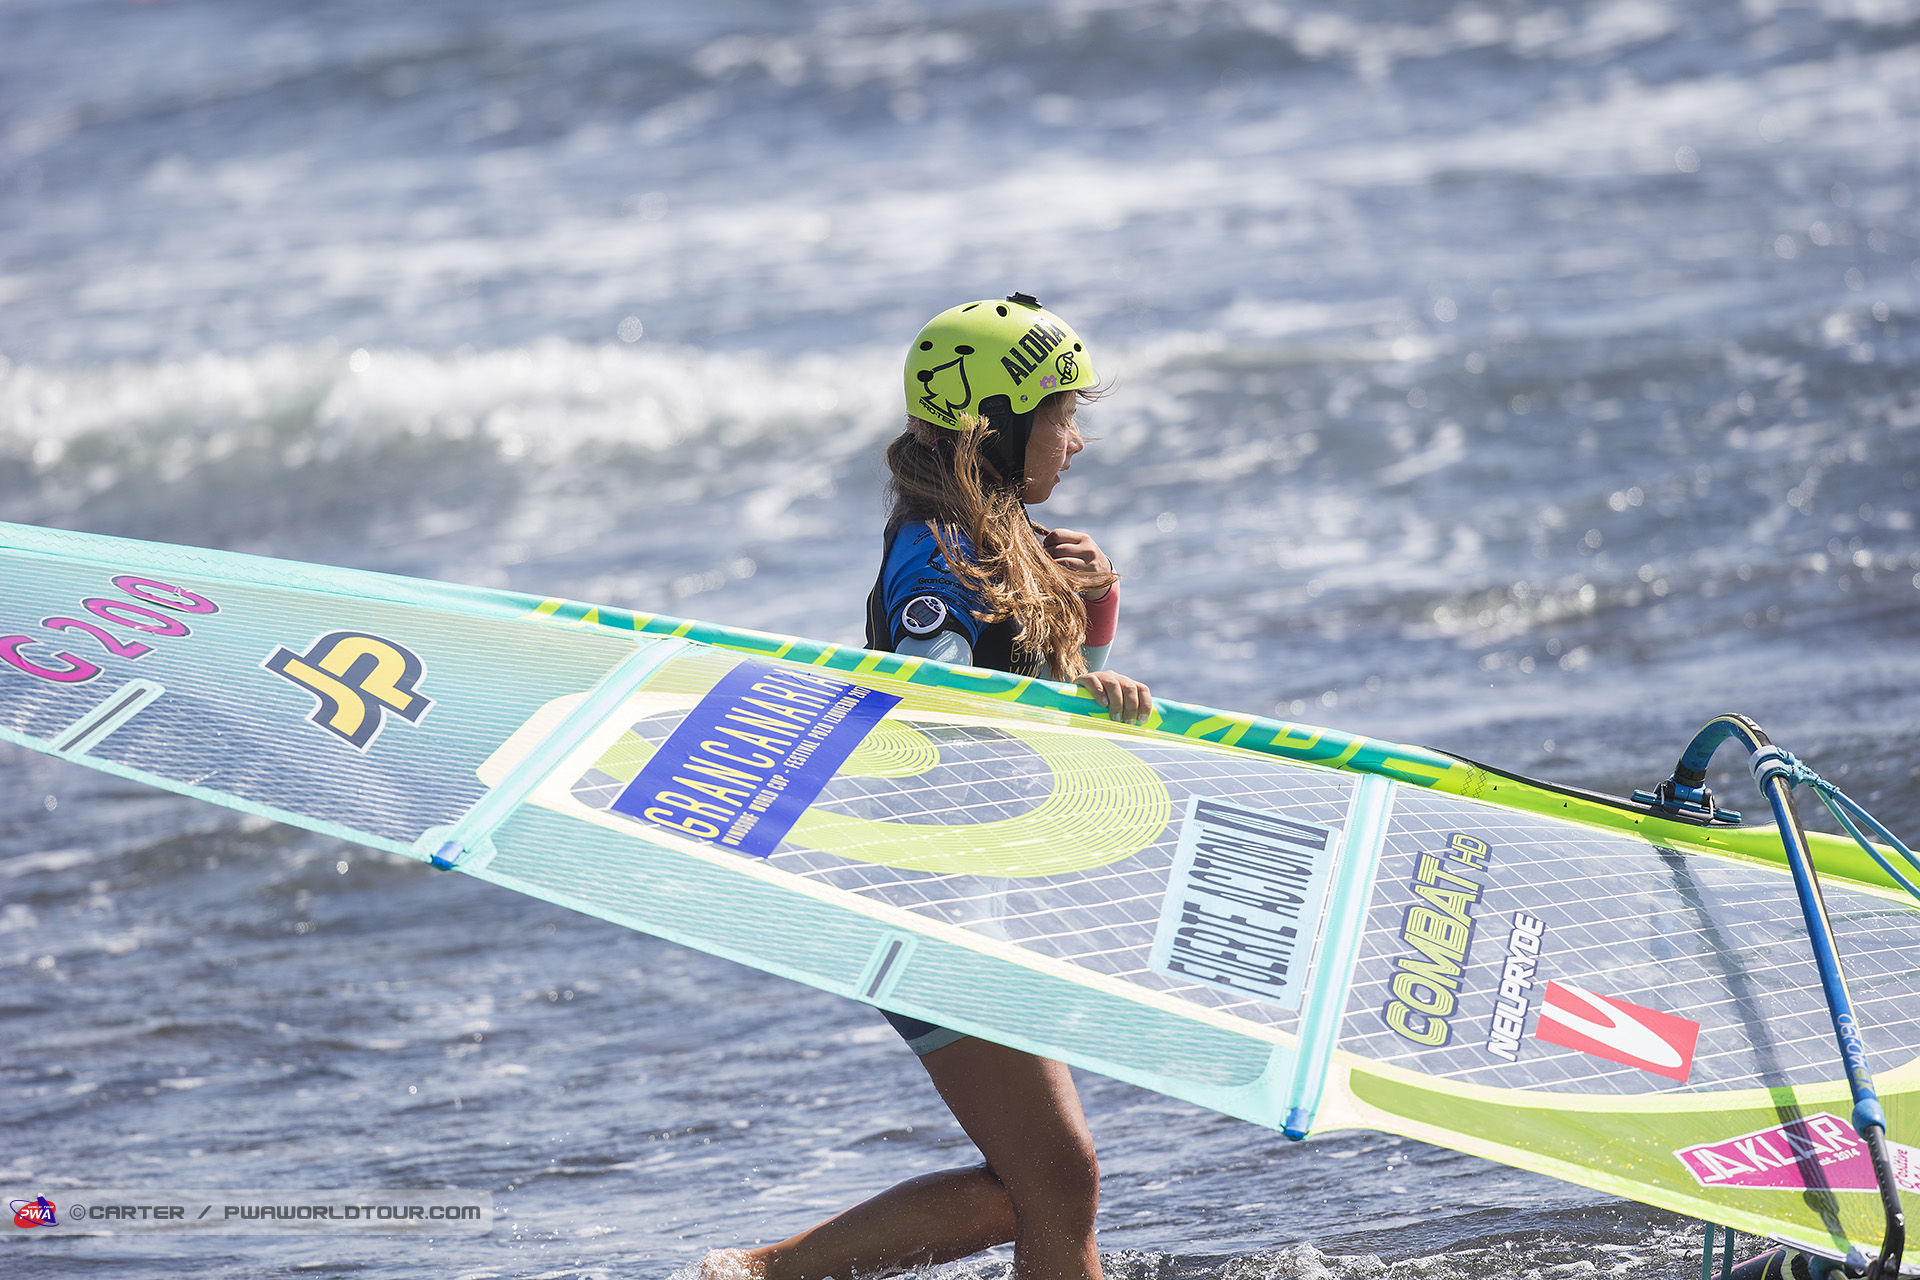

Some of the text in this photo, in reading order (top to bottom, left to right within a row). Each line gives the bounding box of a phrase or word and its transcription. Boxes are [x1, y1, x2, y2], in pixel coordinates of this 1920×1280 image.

[1000, 317, 1067, 386] ALOHA
[748, 788, 779, 814] WORLD
[769, 773, 790, 793] CUP
[783, 740, 821, 770] FESTIVAL
[807, 723, 835, 742] POZO
[1167, 828, 1314, 1000] FUERTE ACTION
[1381, 830, 1494, 1048] COMBAT HD
[1486, 910, 1548, 1062] NEILPRYDE
[1833, 1147, 1861, 1162] 2014
